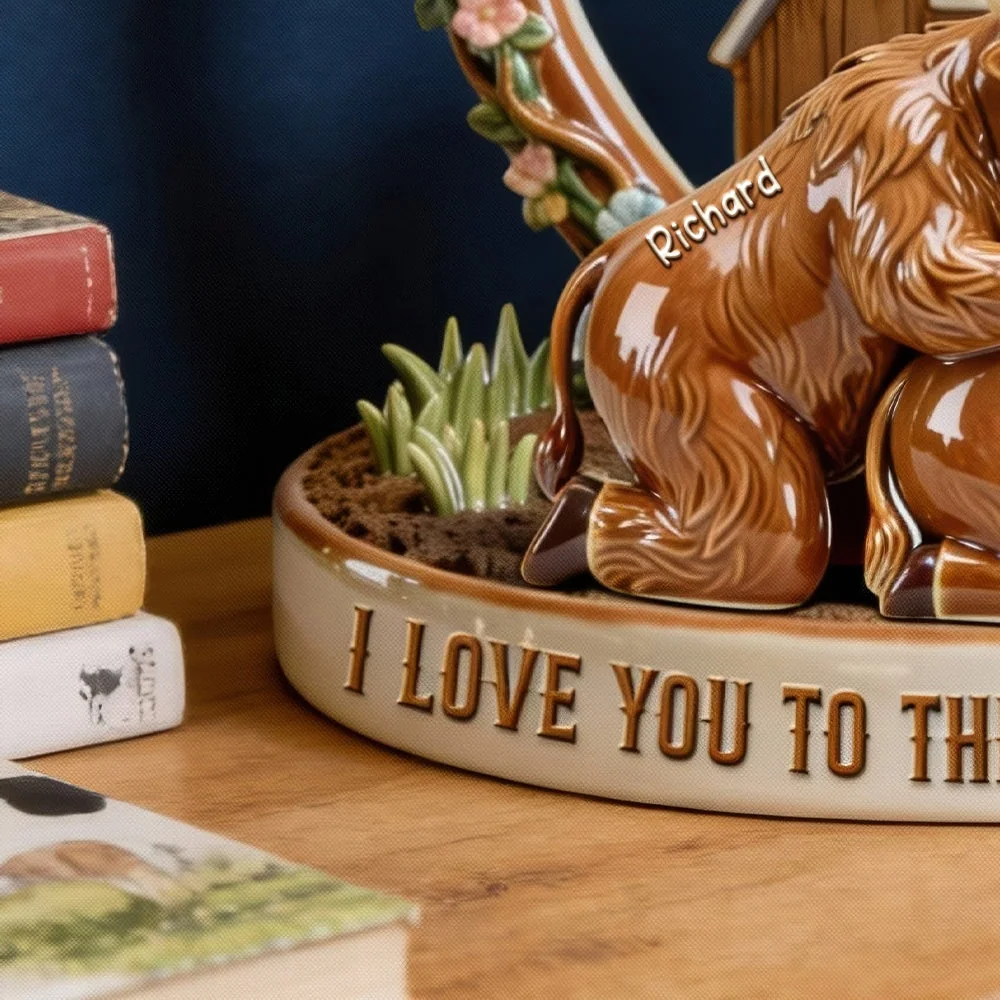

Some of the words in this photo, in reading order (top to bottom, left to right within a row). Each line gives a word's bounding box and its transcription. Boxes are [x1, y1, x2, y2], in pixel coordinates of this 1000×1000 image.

[643, 154, 784, 269] Richard
[343, 605, 374, 696] I
[396, 615, 583, 744] LOVE
[609, 659, 753, 767] YOU
[781, 681, 871, 779] TO
